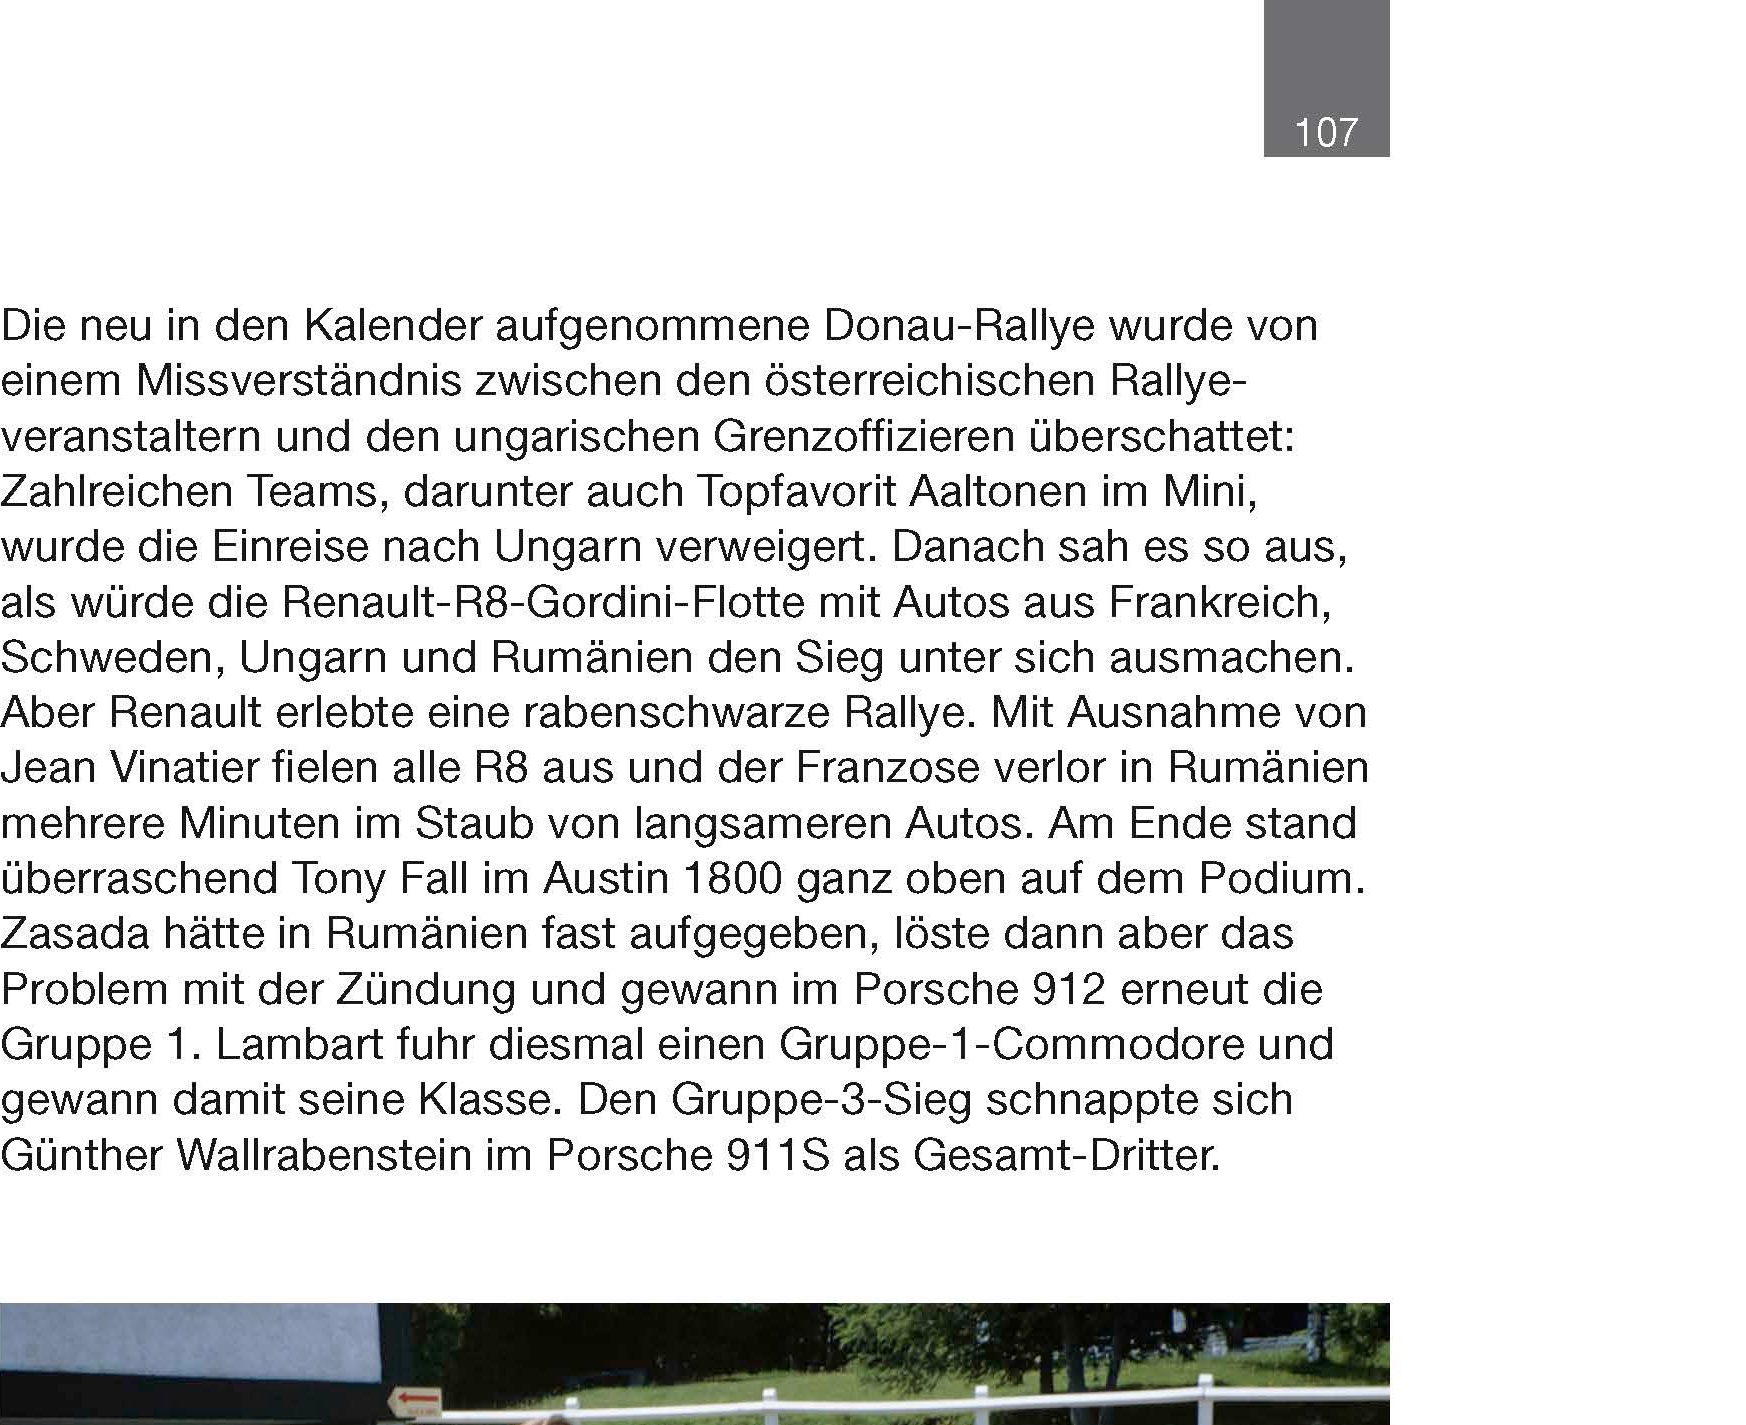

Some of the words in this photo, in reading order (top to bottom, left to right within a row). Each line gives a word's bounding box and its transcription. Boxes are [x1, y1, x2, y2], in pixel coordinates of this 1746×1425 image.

[1297, 117, 1358, 147] 107
[3, 307, 66, 342] Die
[81, 315, 151, 342] neu
[168, 307, 199, 341] in
[215, 307, 288, 342] den
[306, 307, 484, 342] Kalender
[496, 306, 810, 351] aufgenommene
[826, 307, 1095, 351] Donau-Rallye
[1108, 307, 1233, 342] wurde
[1246, 315, 1317, 342] von
[1, 584, 56, 619] als
[70, 584, 194, 619] würde
[208, 584, 268, 619] die
[284, 583, 805, 619] Renault-R8-Gordini-Flotte
[820, 584, 881, 618] mit
[892, 584, 1010, 619] Autos
[1024, 592, 1095, 619] aus
[1111, 584, 1330, 625] Frankreich,
[1, 1136, 164, 1172] Günther
[176, 1137, 471, 1172] Wallrabenstein
[487, 1137, 531, 1171] im
[549, 1137, 713, 1172] Porsche
[727, 1136, 830, 1172] 911S
[844, 1137, 900, 1172] als
[914, 1136, 1219, 1172] Gesamt-Dritter.
